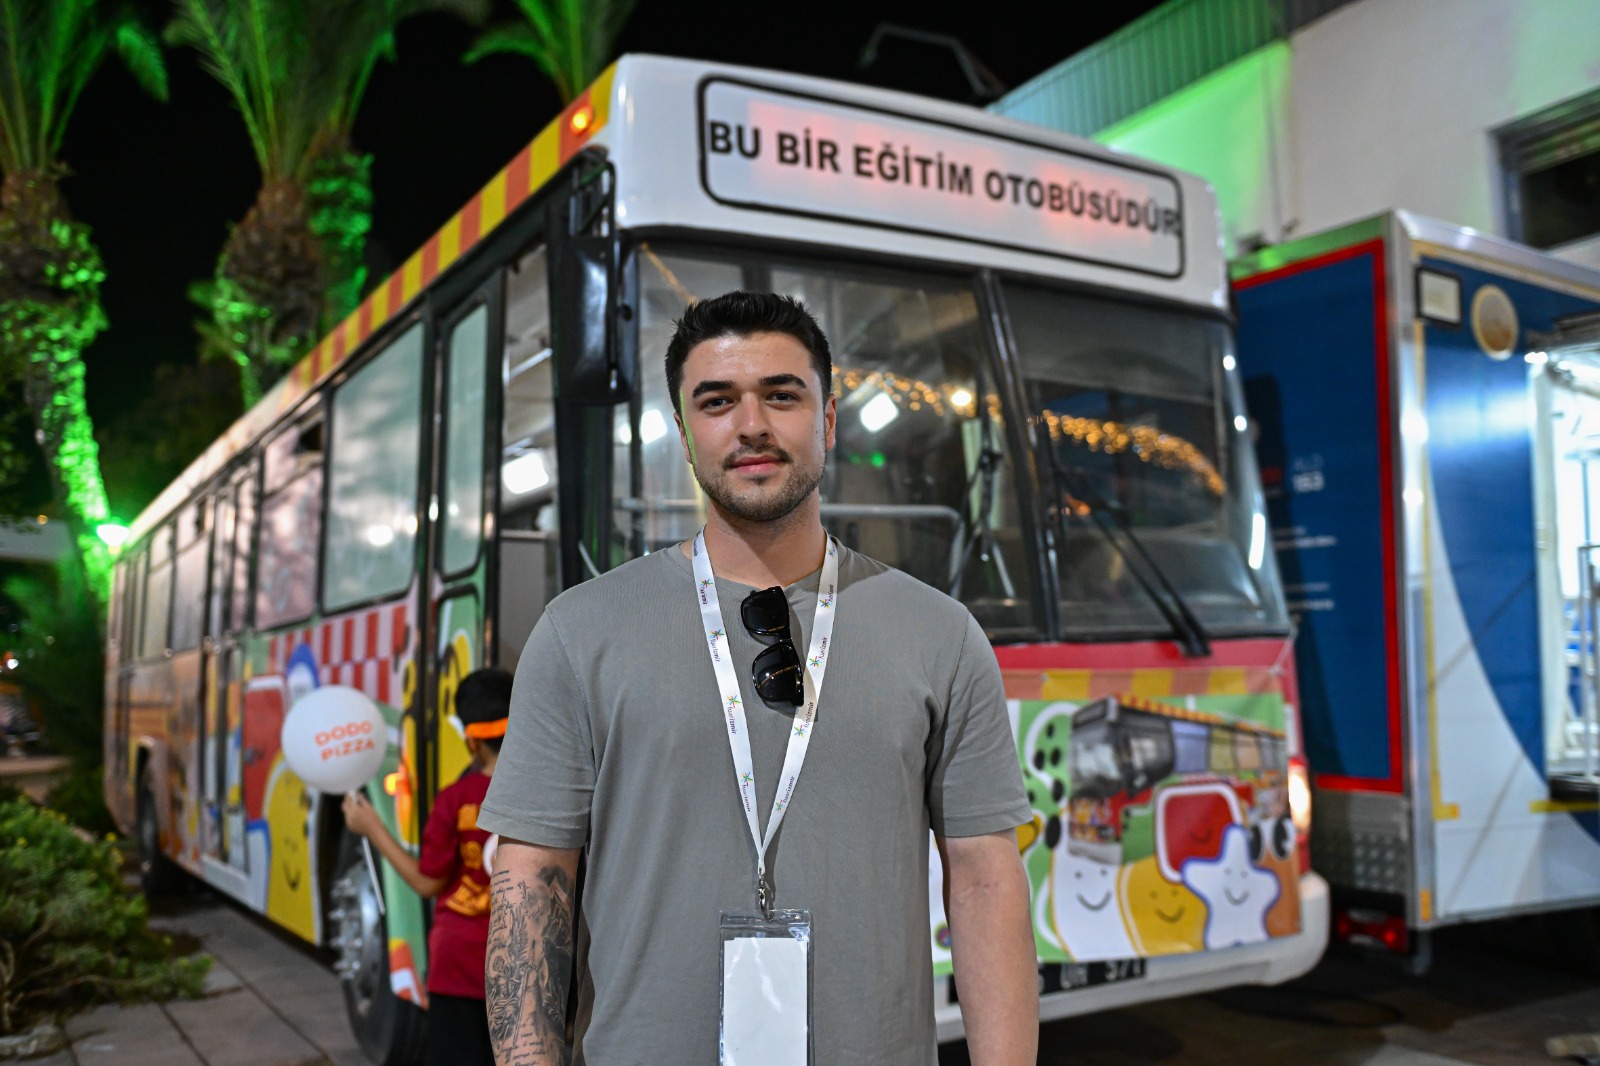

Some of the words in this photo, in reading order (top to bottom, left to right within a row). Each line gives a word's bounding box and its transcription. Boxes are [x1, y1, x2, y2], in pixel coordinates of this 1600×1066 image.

[709, 120, 761, 159] BU
[777, 128, 841, 174] BİR
[854, 143, 974, 197] EĞİTİM
[984, 169, 1182, 236] OTOBÜSÜDÜR
[315, 721, 373, 747] DODO
[321, 739, 374, 761] PIZZA
